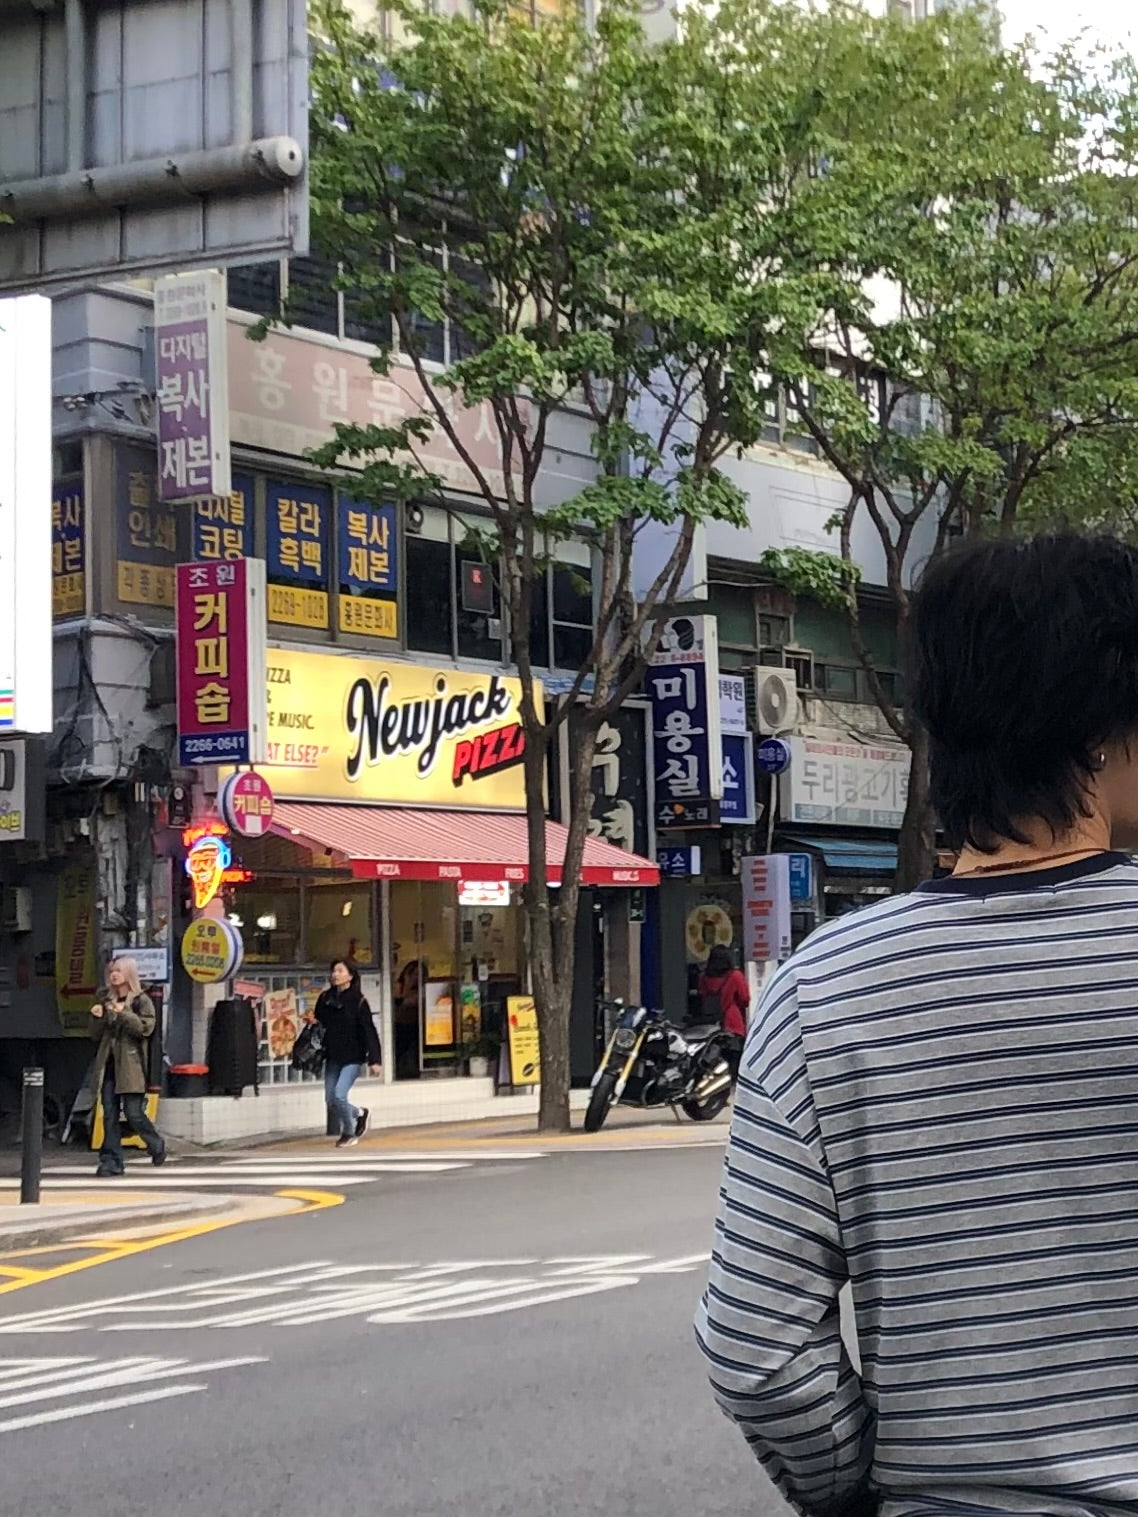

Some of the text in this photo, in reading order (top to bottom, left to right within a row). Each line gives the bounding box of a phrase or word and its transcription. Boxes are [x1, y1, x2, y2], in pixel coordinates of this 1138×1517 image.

[160, 369, 210, 422] 복사
[162, 435, 211, 488] 제본
[278, 498, 321, 537] 칼라
[348, 510, 390, 549] 복사
[200, 525, 243, 560] 코팅
[279, 537, 322, 576] 흑백
[348, 547, 390, 584] 제본
[194, 592, 231, 724] 커피숍
[267, 667, 291, 684] IZZA
[346, 674, 509, 777] Newjack
[652, 668, 704, 797] 미용실
